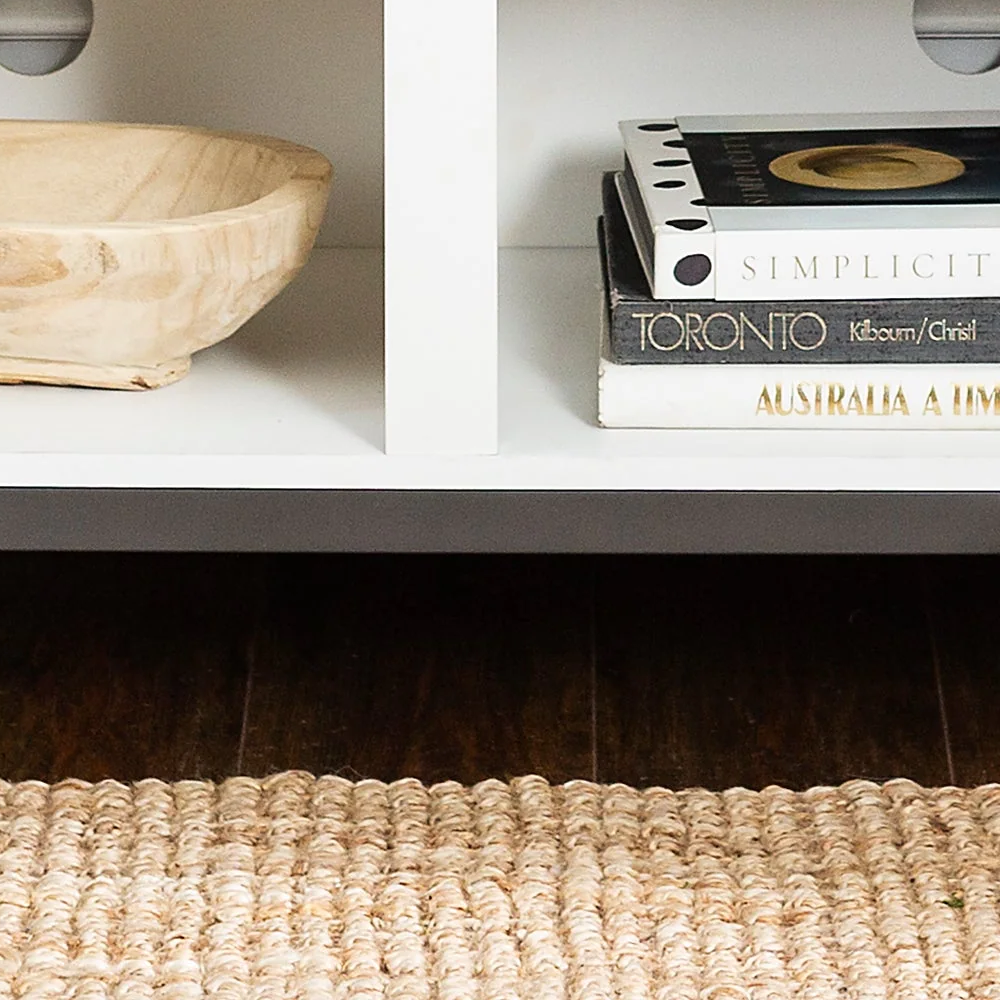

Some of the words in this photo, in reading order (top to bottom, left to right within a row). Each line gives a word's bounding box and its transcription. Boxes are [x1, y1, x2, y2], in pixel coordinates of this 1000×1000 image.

[742, 252, 991, 281] SIMPLICIT
[632, 311, 828, 351] TORONTO
[755, 382, 910, 417] AUSTRALIA
[922, 384, 943, 416] A
